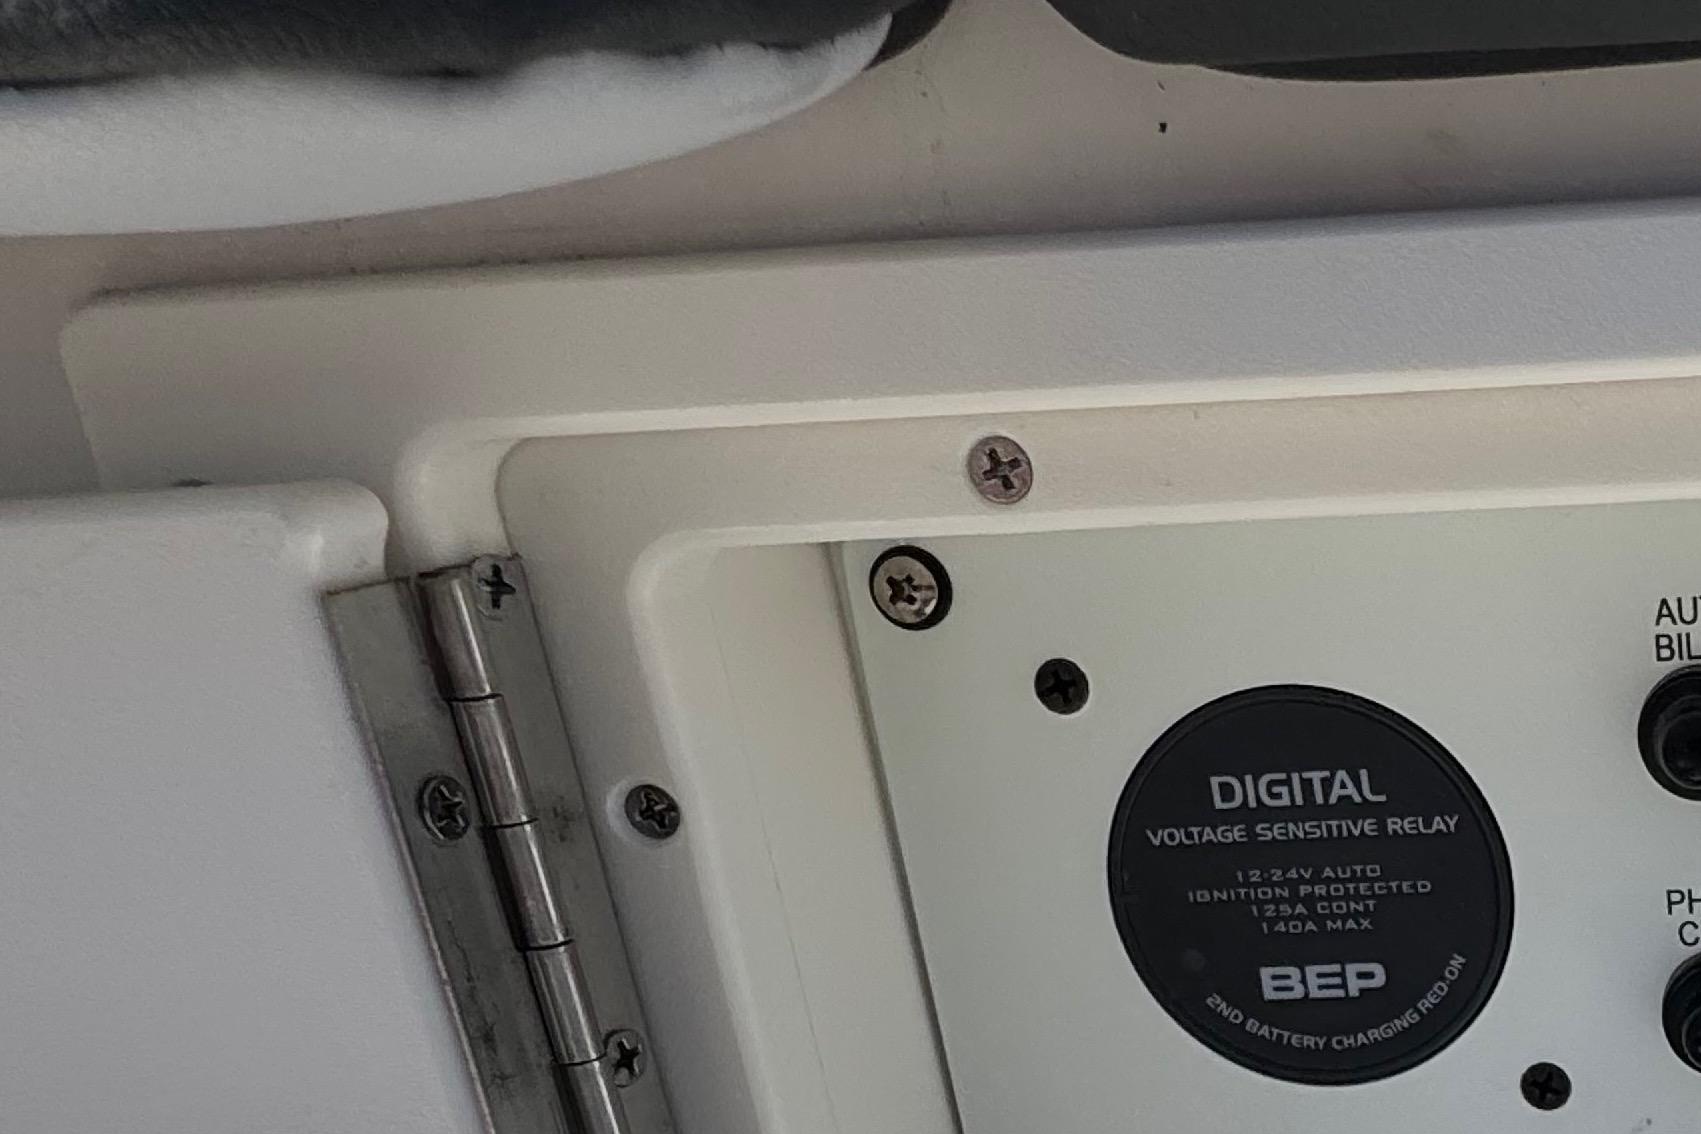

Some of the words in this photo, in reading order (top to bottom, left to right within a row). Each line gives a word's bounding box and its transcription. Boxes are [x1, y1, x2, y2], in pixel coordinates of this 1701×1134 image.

[1210, 769, 1387, 810] DIGITAL
[1146, 824, 1249, 847] VOLTAGE
[1255, 818, 1380, 842] SENSITIVE
[1387, 814, 1460, 836] RELAY
[1321, 864, 1382, 880] AUTO
[1188, 885, 1290, 904] IGNITION
[1299, 880, 1432, 898] PROTECTED
[1251, 904, 1308, 918] 125A
[1317, 900, 1377, 915] CONT
[1262, 920, 1318, 935] 140A
[1326, 918, 1374, 932] MAX
[1259, 962, 1387, 1001] BEP
[1205, 992, 1245, 1024] 2ND
[1245, 1017, 1327, 1050] BATTERY
[1331, 1008, 1420, 1050] CHARGING
